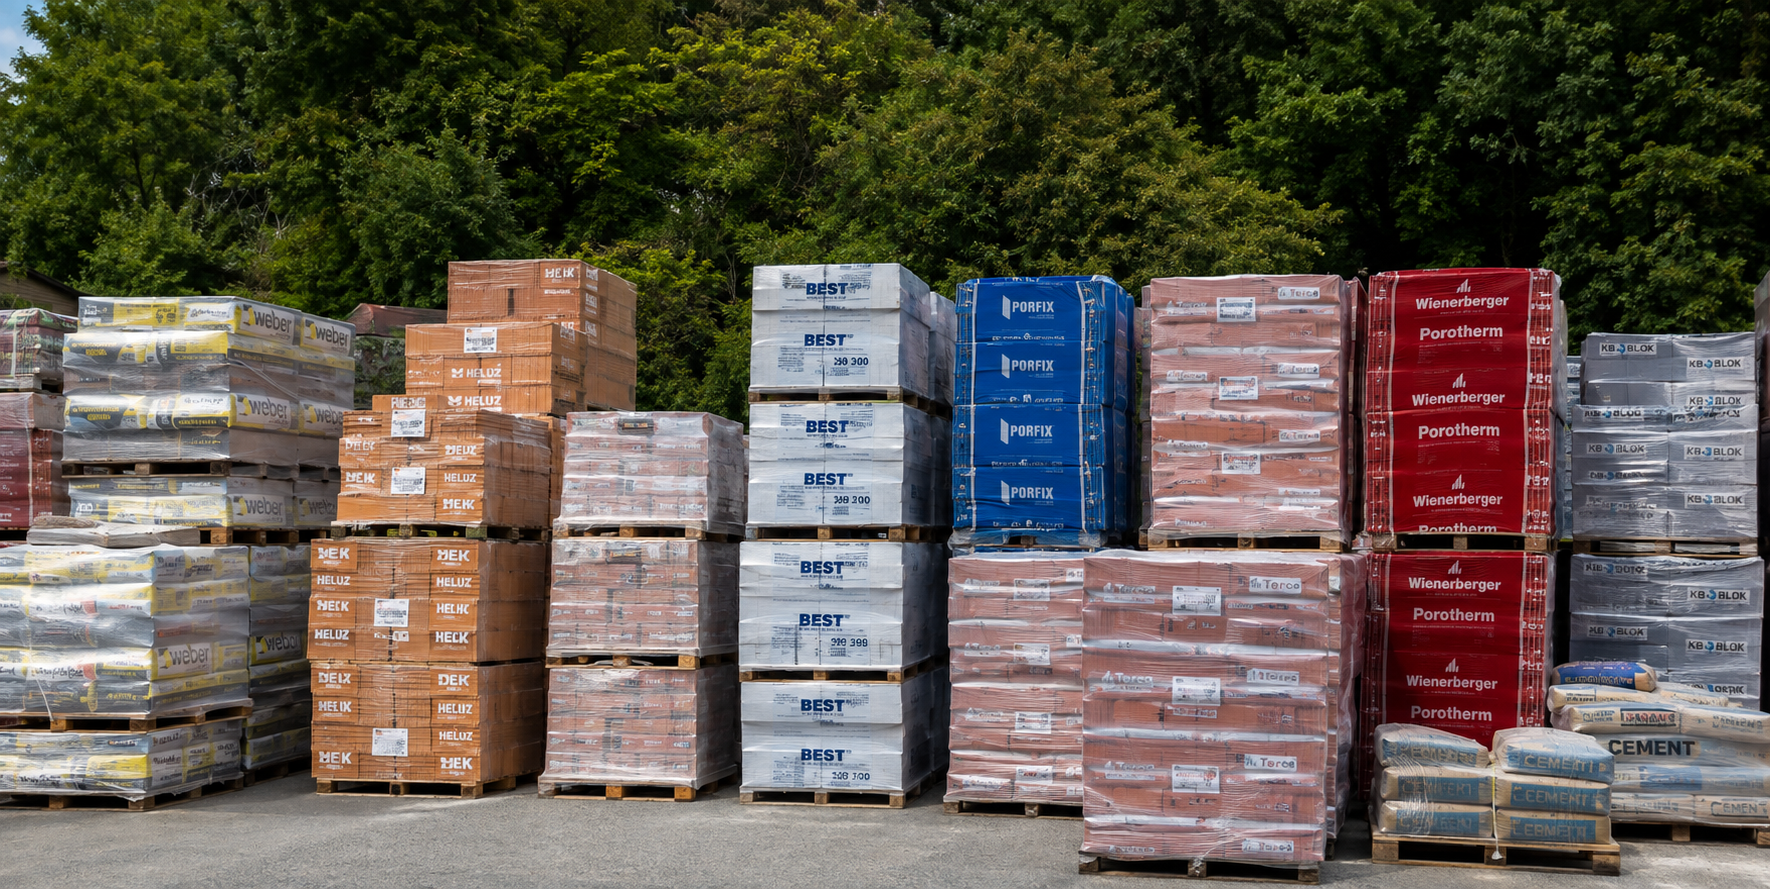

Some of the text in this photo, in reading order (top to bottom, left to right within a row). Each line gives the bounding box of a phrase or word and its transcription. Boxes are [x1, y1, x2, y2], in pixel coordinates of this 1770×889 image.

[806, 282, 848, 295] BEST
[1012, 301, 1054, 313] PORFIX
[1415, 295, 1509, 310] Wienerberger
[254, 310, 292, 333] weber
[315, 326, 349, 345] weber
[1420, 325, 1503, 341] Porotherm
[804, 334, 847, 346] BEST
[1601, 343, 1654, 352] KB BLOK
[1011, 360, 1054, 372] PORFIX
[1688, 359, 1741, 368] KB BLOK
[1412, 391, 1505, 406] Wienerberger
[250, 397, 287, 419] weber
[805, 420, 848, 433] BEST
[1010, 425, 1053, 437] PORFIX
[1418, 422, 1500, 439] Porotherm
[1686, 446, 1743, 456] KB BLOK
[804, 473, 847, 485] BEST
[1011, 487, 1053, 499] PORFIX
[247, 497, 283, 516] weber
[1413, 493, 1503, 507] Wienerberger
[800, 561, 844, 574] BEST
[316, 575, 351, 586] HELUZ
[436, 577, 472, 588] HELUZ
[1408, 577, 1502, 593] Wienerberger
[1690, 590, 1747, 600] KB BLOK
[799, 613, 844, 627] BEST
[1413, 607, 1495, 622] Porotherm
[1688, 640, 1745, 652] KB BLOK
[171, 646, 209, 666] weber
[1406, 675, 1498, 691] Wienerberger
[800, 698, 844, 712] BEST
[1411, 705, 1492, 721] Porotherm
[1608, 739, 1696, 756] CEMENT
[801, 748, 846, 761] BEST
